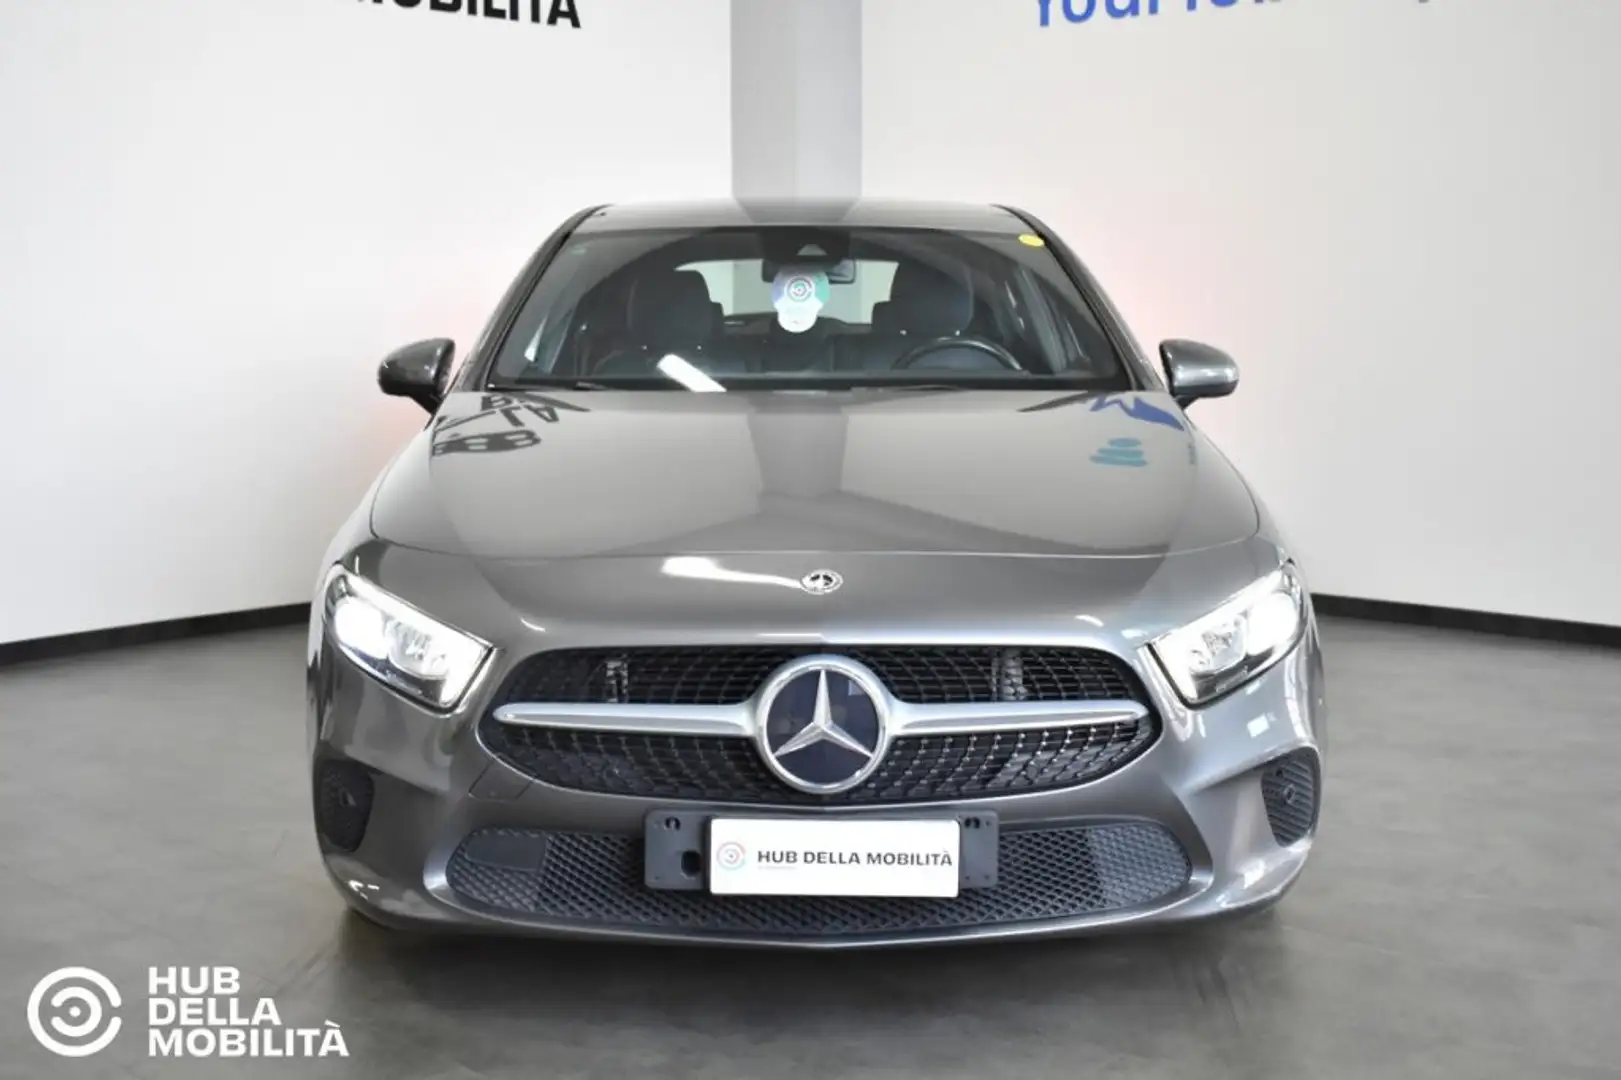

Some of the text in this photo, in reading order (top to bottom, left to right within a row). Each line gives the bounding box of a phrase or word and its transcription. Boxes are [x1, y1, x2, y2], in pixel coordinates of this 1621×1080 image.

[757, 850, 953, 866] HUB DELLA MOBILITÀ
